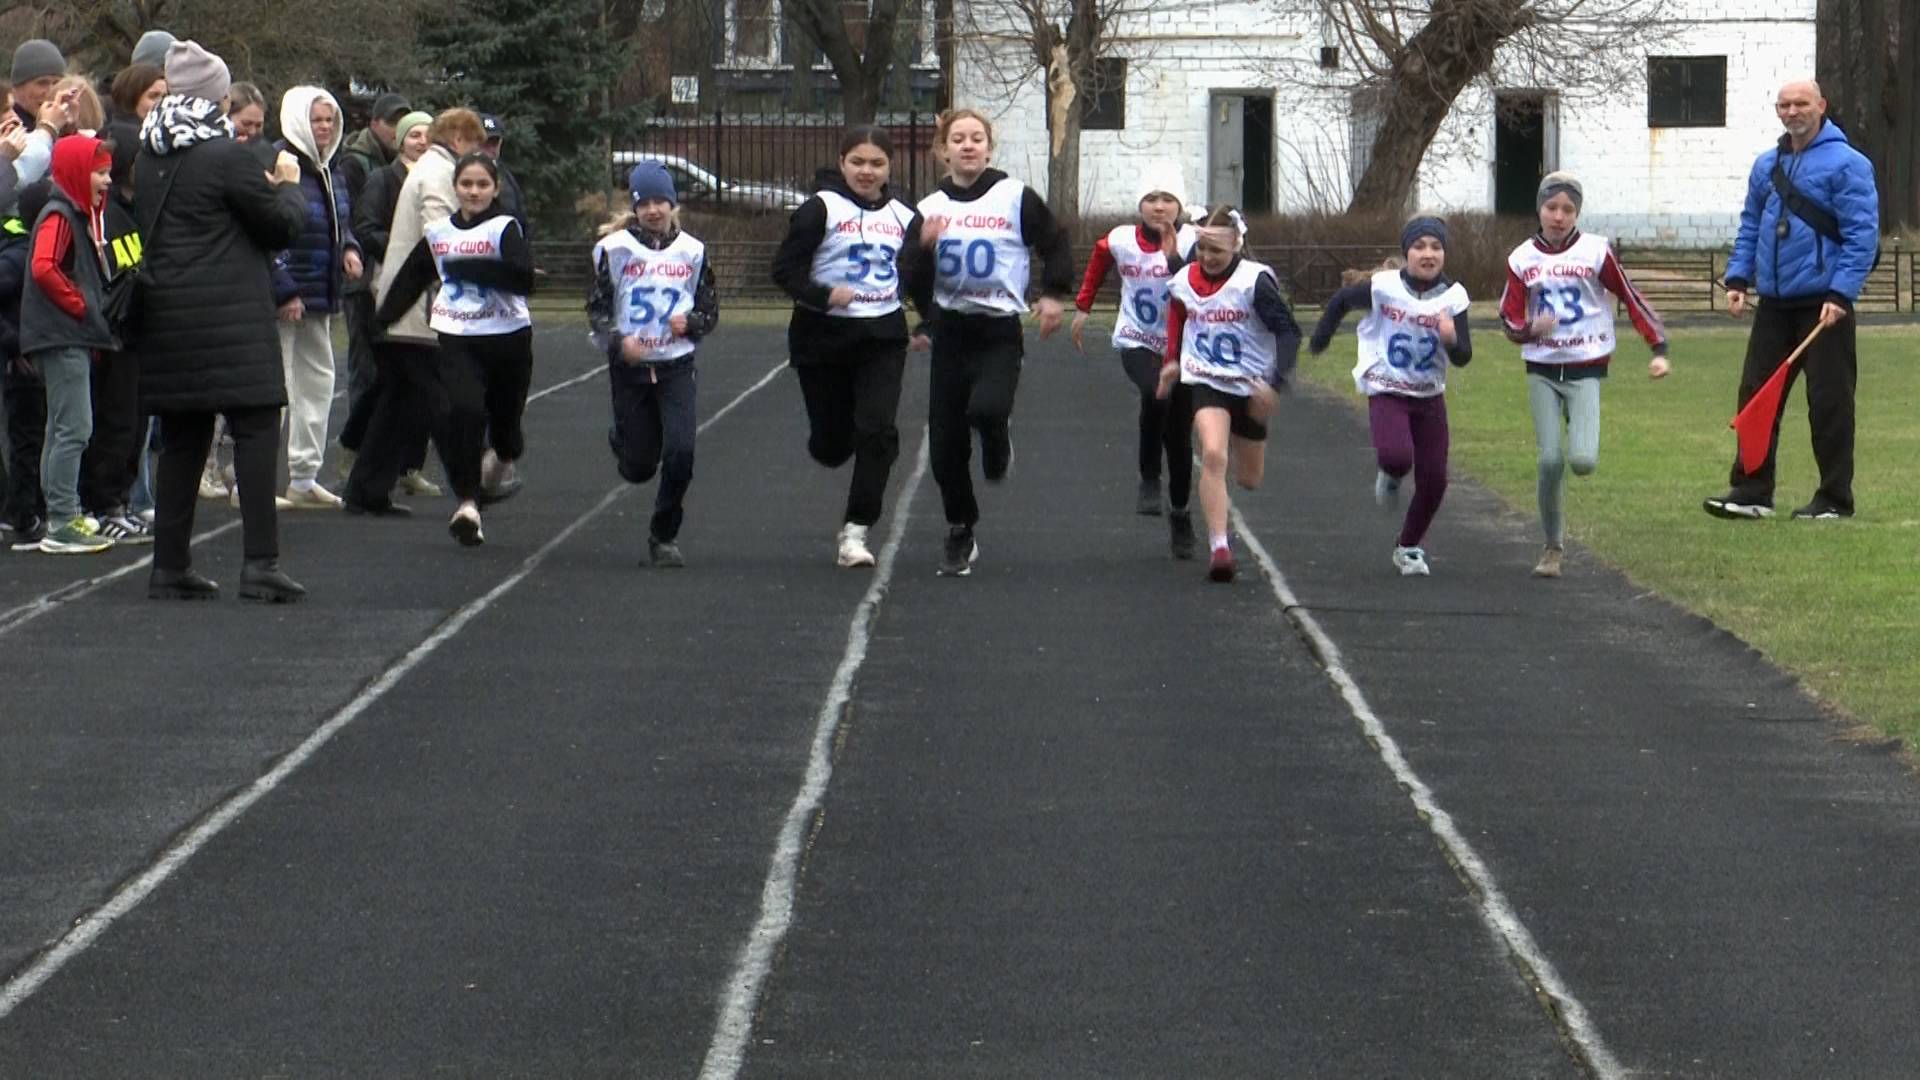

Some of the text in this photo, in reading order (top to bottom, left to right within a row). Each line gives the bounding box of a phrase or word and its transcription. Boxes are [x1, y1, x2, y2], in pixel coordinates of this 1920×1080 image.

[845, 243, 896, 281] 53
[937, 239, 996, 279] 50
[1134, 287, 1171, 325] 6
[1388, 332, 1439, 372] 62
